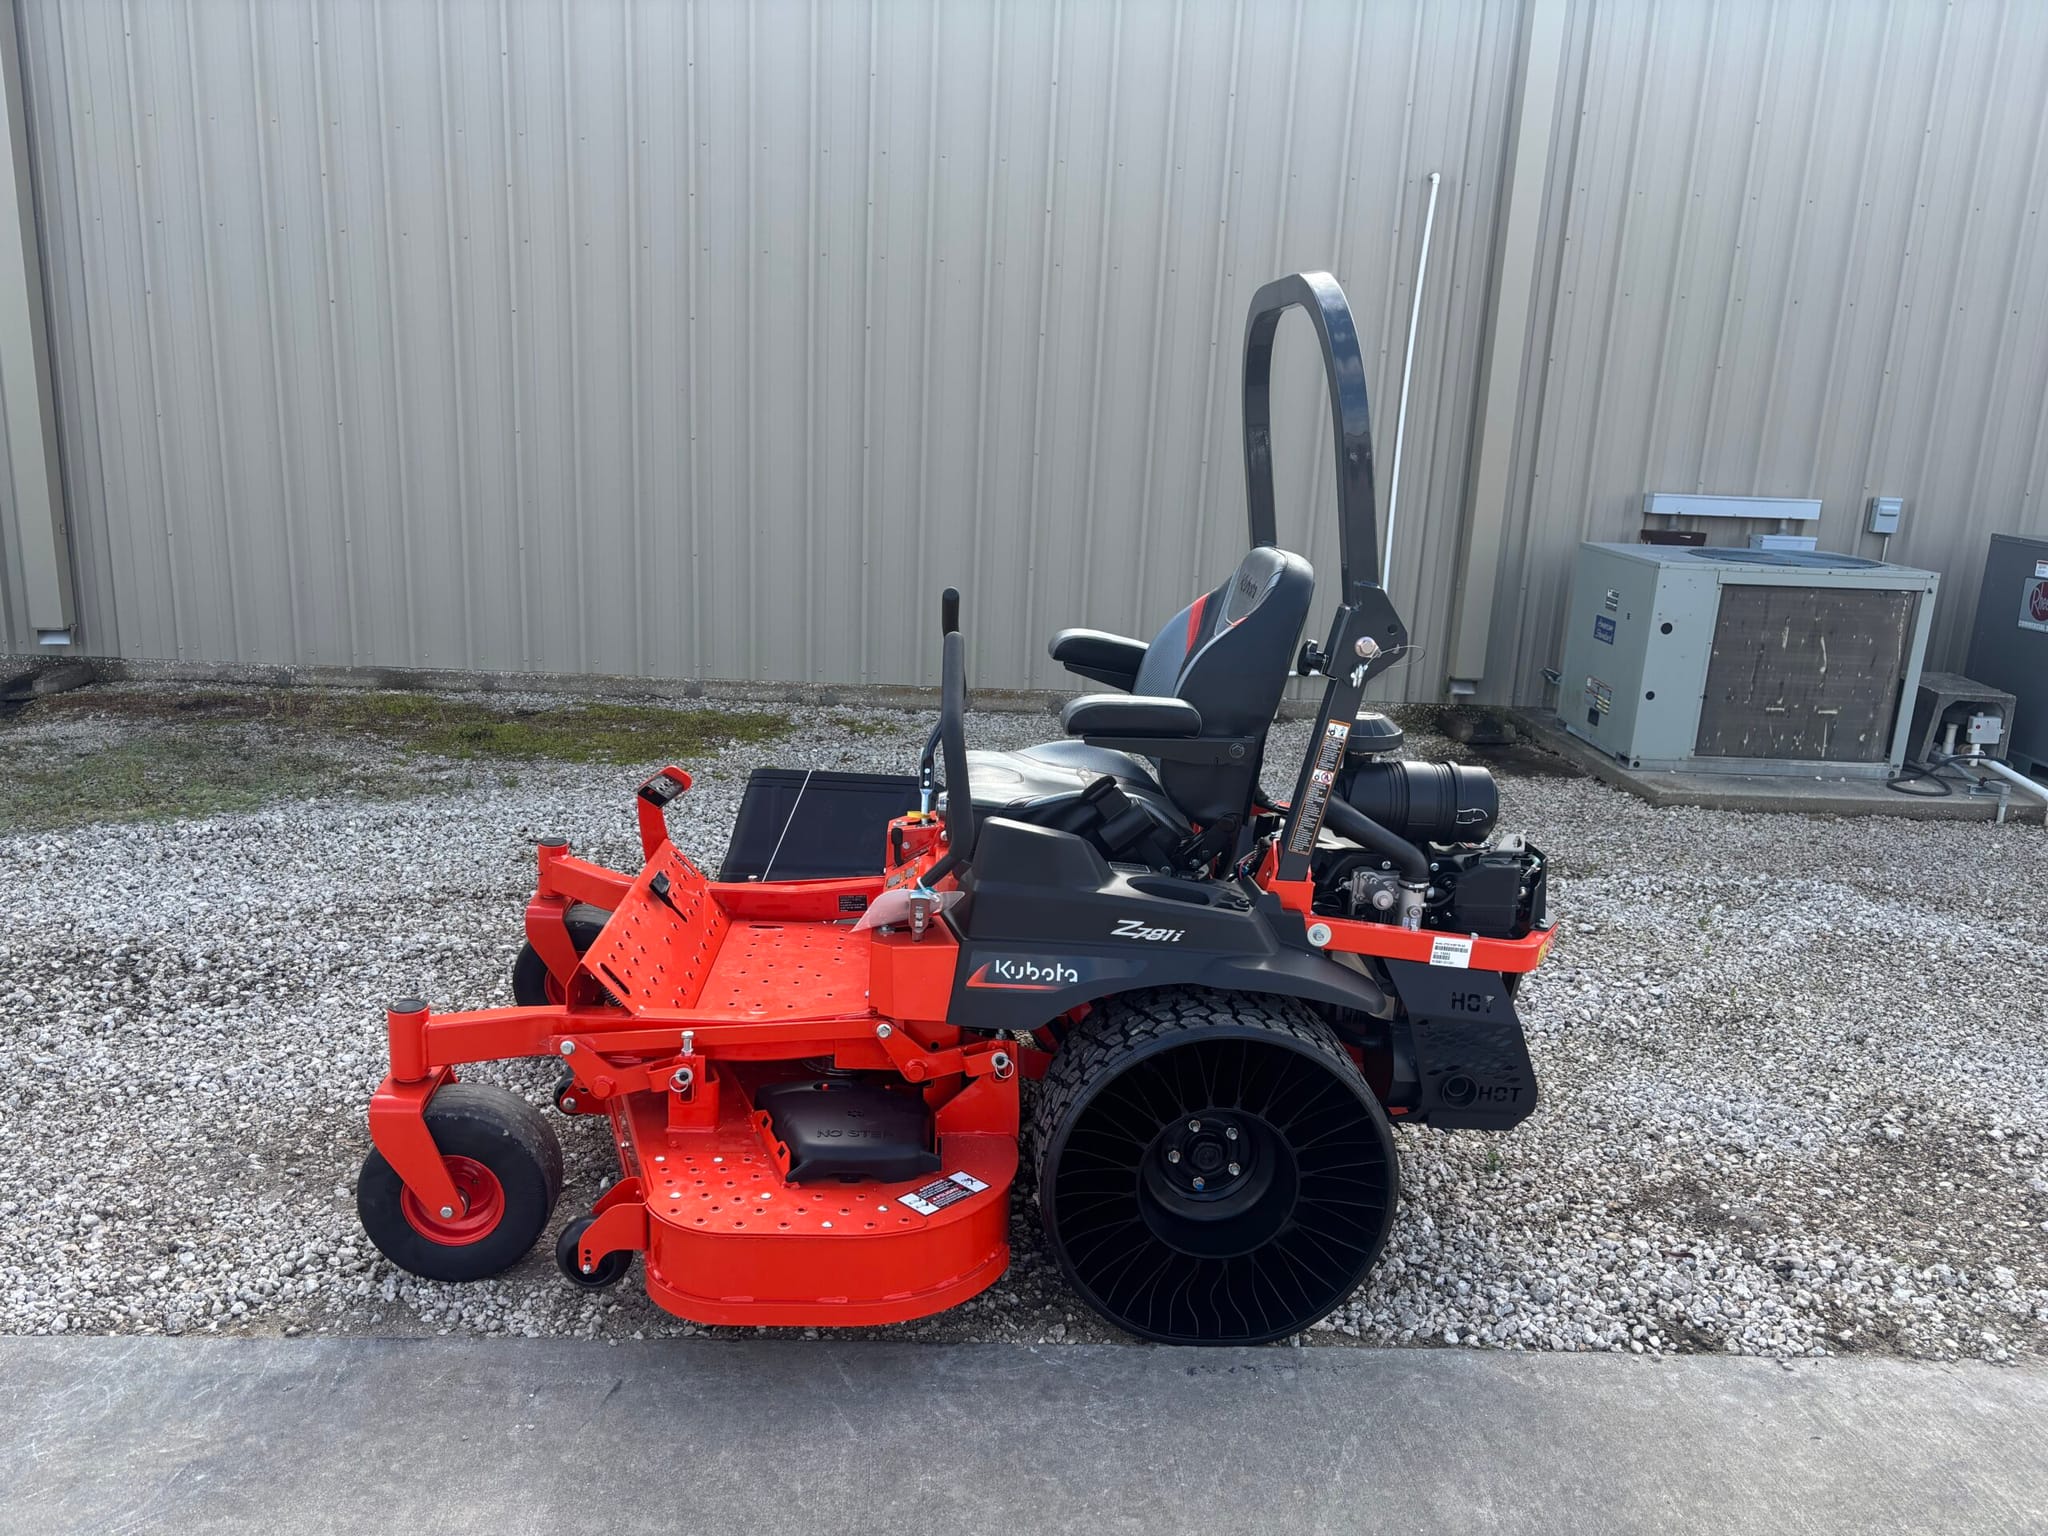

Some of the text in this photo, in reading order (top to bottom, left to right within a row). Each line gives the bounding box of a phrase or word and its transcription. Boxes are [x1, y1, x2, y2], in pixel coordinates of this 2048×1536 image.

[1110, 919, 1186, 942] Z781i
[995, 959, 1079, 983] Kubota
[1451, 992, 1496, 1014] HOT
[1478, 1086, 1523, 1103] HOT
[817, 1127, 843, 1138] NO
